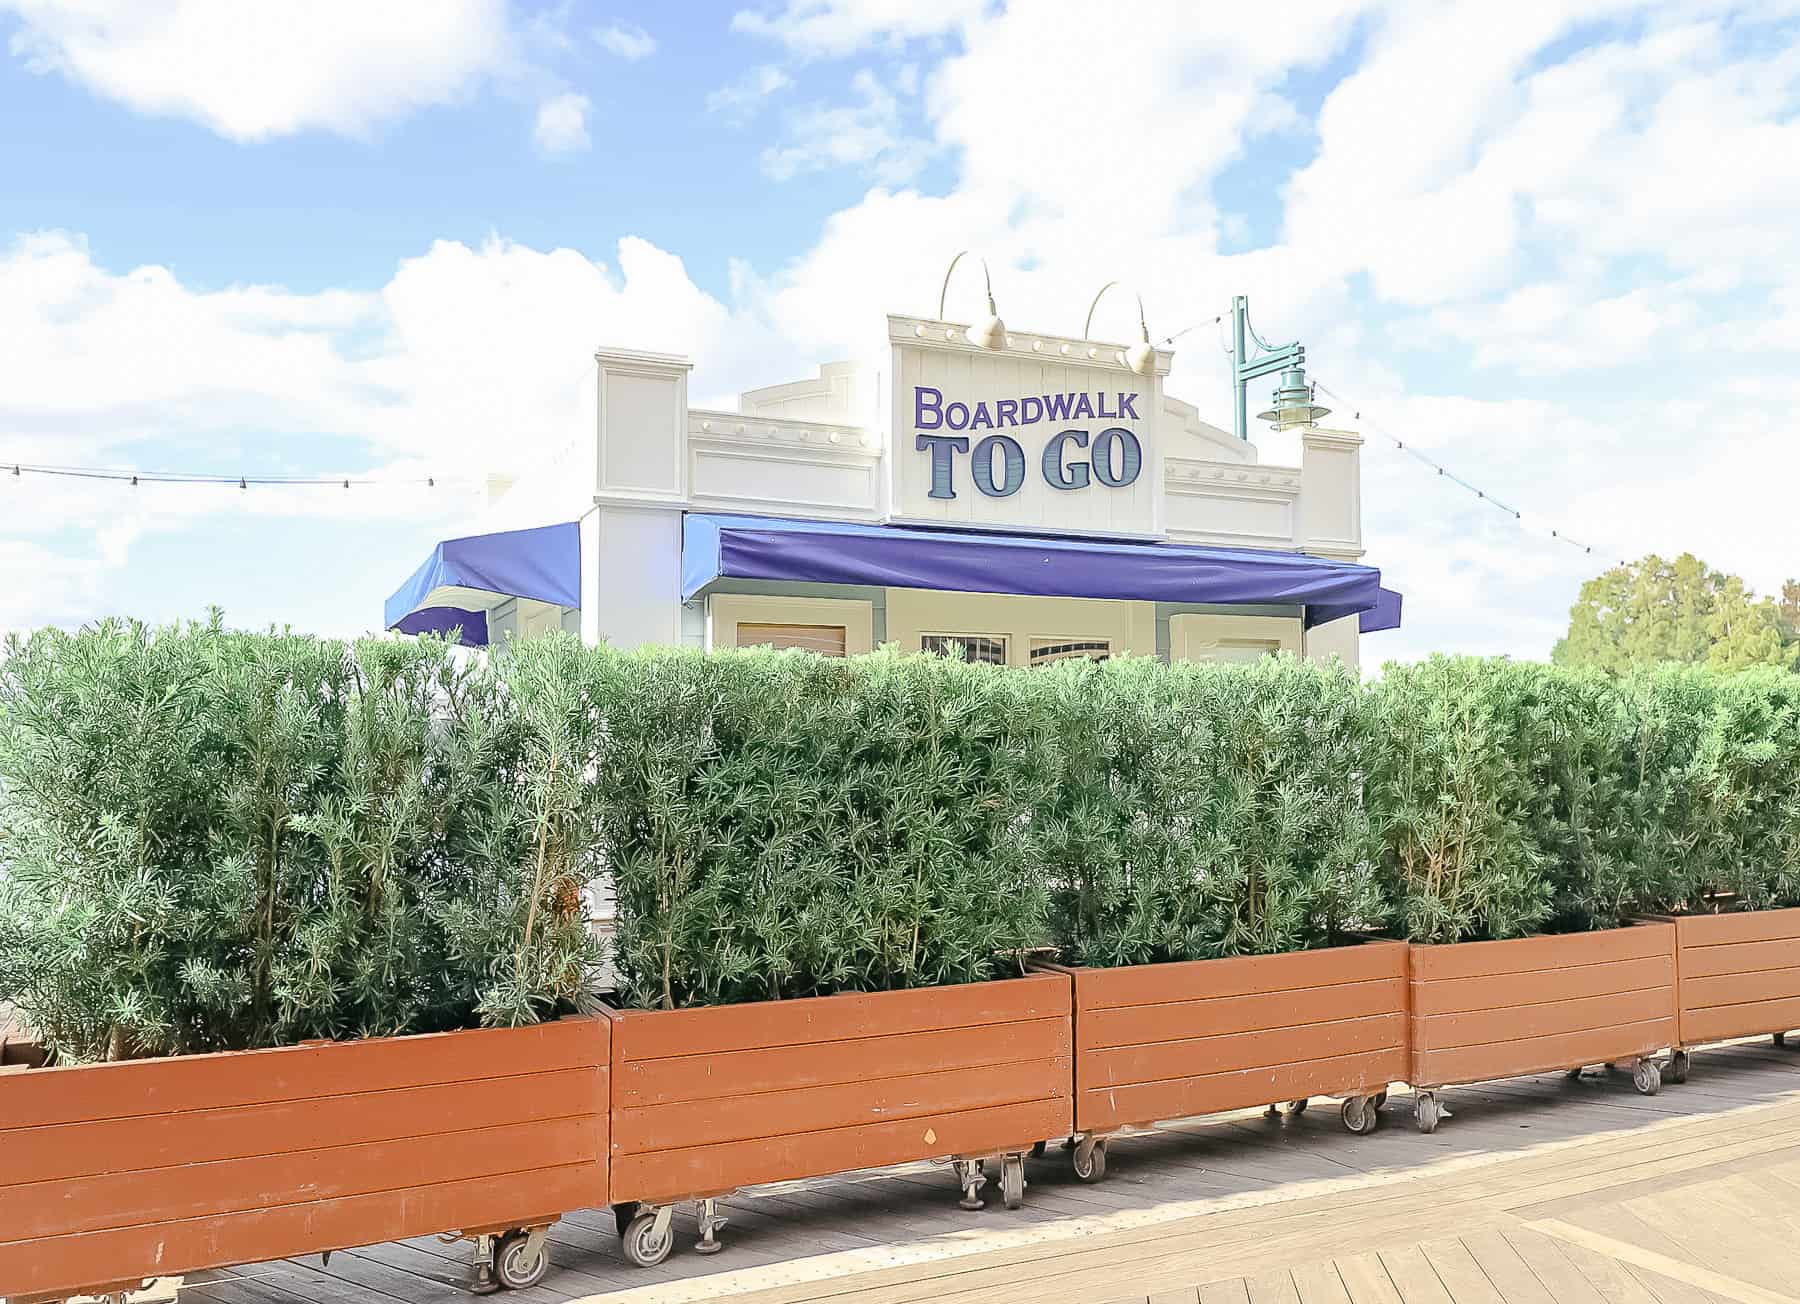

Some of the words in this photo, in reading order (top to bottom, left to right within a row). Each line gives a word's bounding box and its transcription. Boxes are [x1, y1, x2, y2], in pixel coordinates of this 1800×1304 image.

[914, 386, 1140, 431] BOARDWALK
[915, 433, 1026, 499] TO
[1041, 427, 1142, 490] GO
